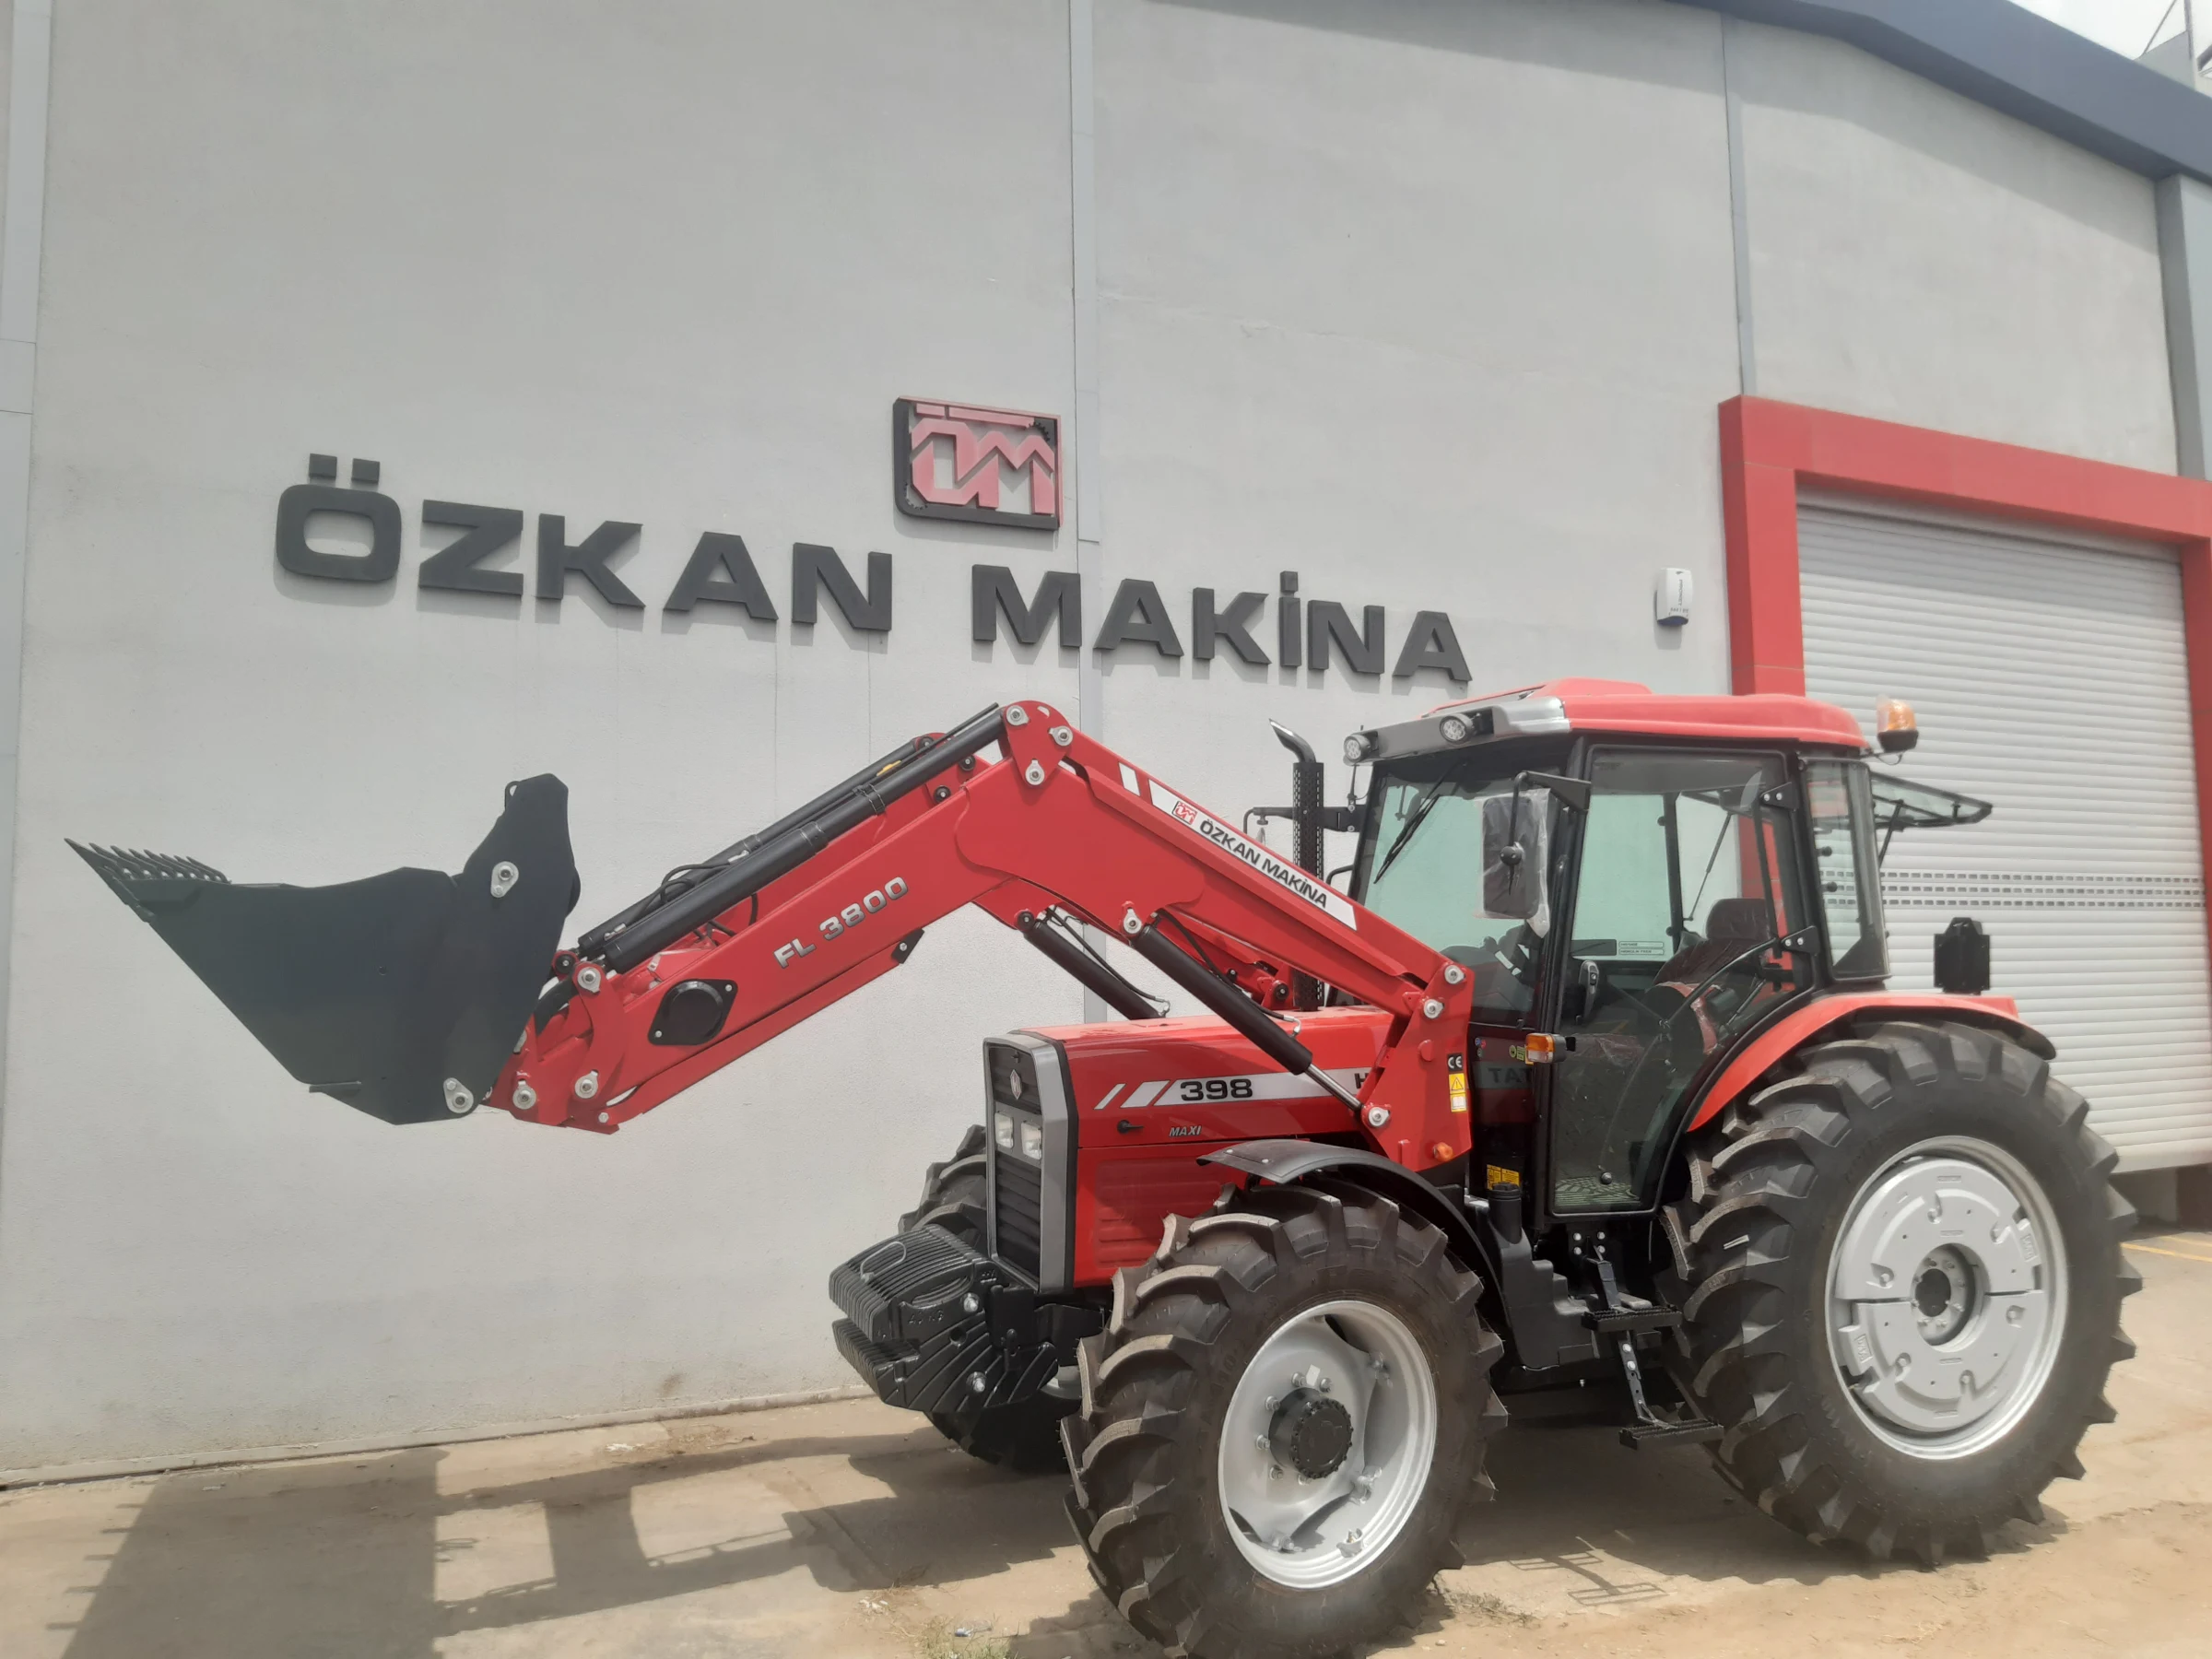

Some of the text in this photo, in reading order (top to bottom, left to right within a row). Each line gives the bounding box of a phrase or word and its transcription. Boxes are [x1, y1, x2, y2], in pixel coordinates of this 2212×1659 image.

[276, 453, 1472, 682] ÖZKAN MAKİNA
[1199, 818, 1327, 909] ÖZKAN MAKİNA
[773, 876, 909, 970] FL 3800
[1169, 1125, 1202, 1138] MAXI
[1180, 1078, 1253, 1101] 398
